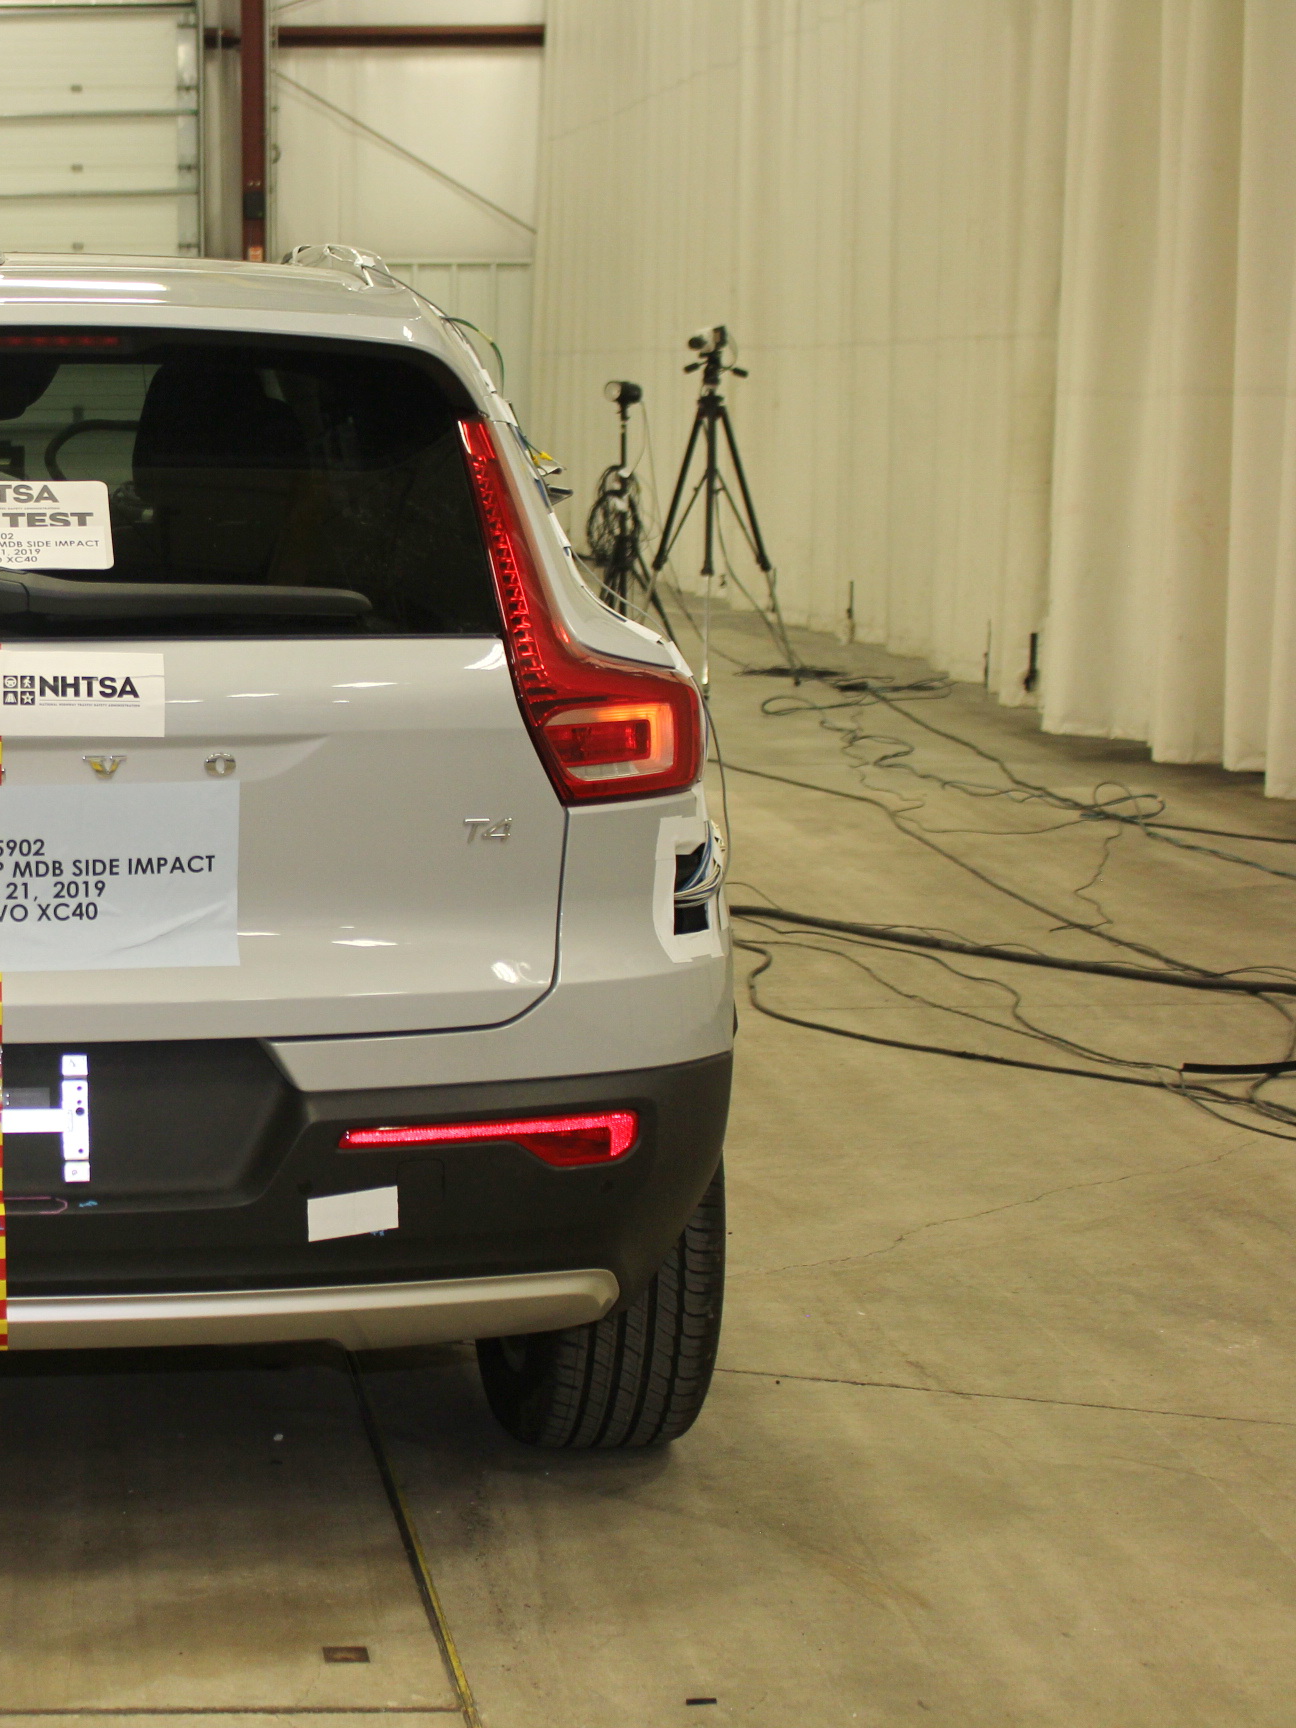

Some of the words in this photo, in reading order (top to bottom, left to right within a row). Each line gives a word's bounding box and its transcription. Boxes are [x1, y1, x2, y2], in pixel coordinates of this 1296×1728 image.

[2, 511, 94, 528] TEST
[14, 548, 41, 556] 2019
[27, 540, 52, 548] SIDE
[7, 555, 38, 564] XC40
[39, 675, 140, 699] NHTSA
[463, 817, 513, 844] T4
[12, 860, 64, 879] MDB
[71, 858, 120, 877] SIDE
[128, 854, 216, 876] IMPACT
[5, 882, 38, 903] 21,
[52, 880, 106, 900] 2019
[37, 901, 98, 922] XC40
